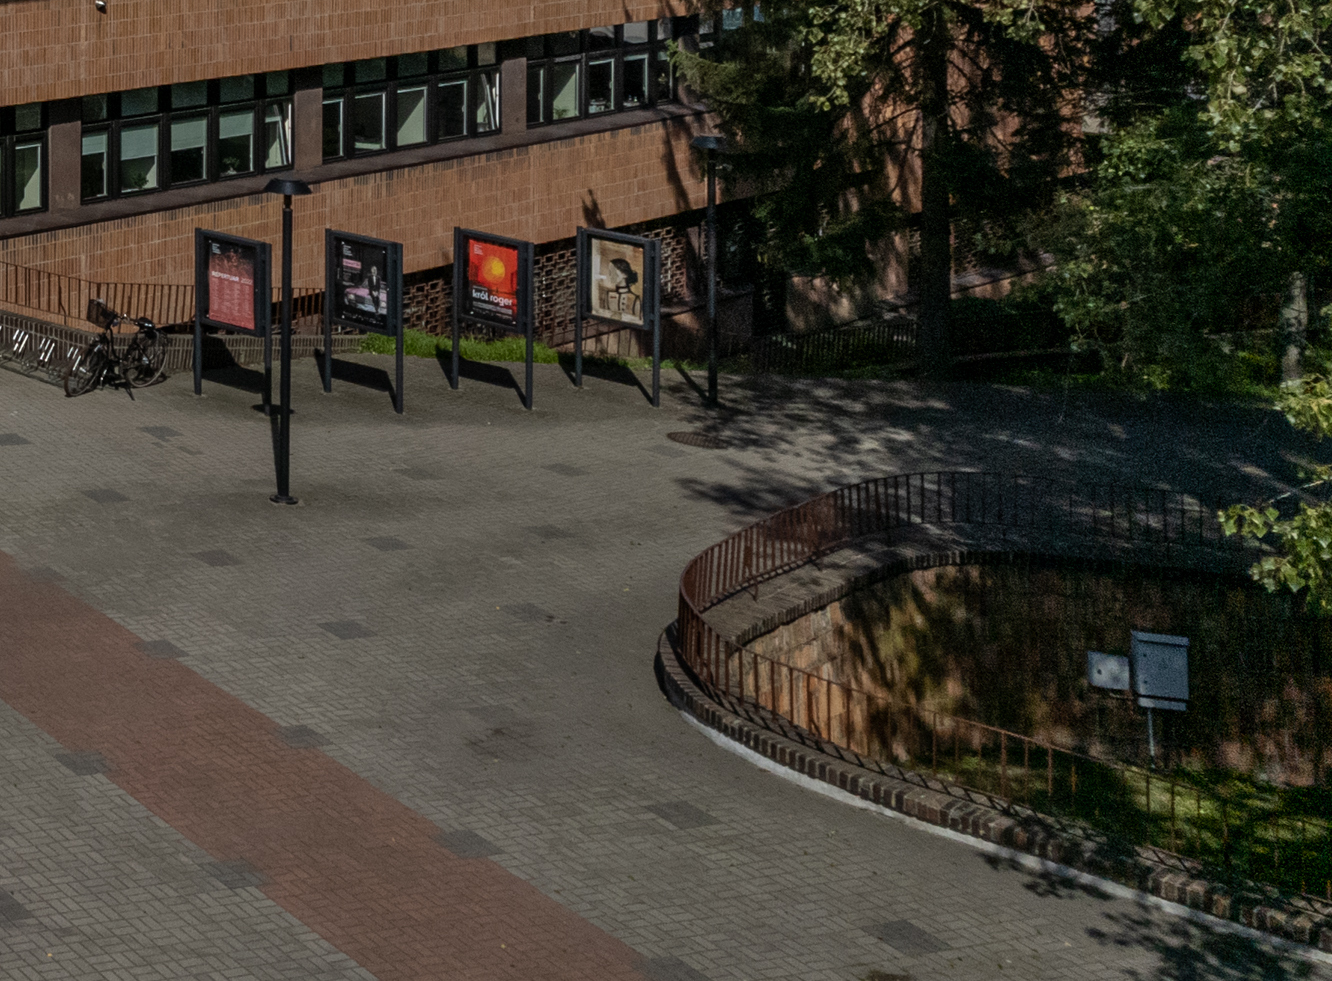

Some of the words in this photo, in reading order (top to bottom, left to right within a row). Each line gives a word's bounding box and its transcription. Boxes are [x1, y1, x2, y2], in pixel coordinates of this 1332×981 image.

[212, 271, 239, 282] REPERTUAR
[472, 289, 489, 300] król
[490, 296, 512, 306] roger
